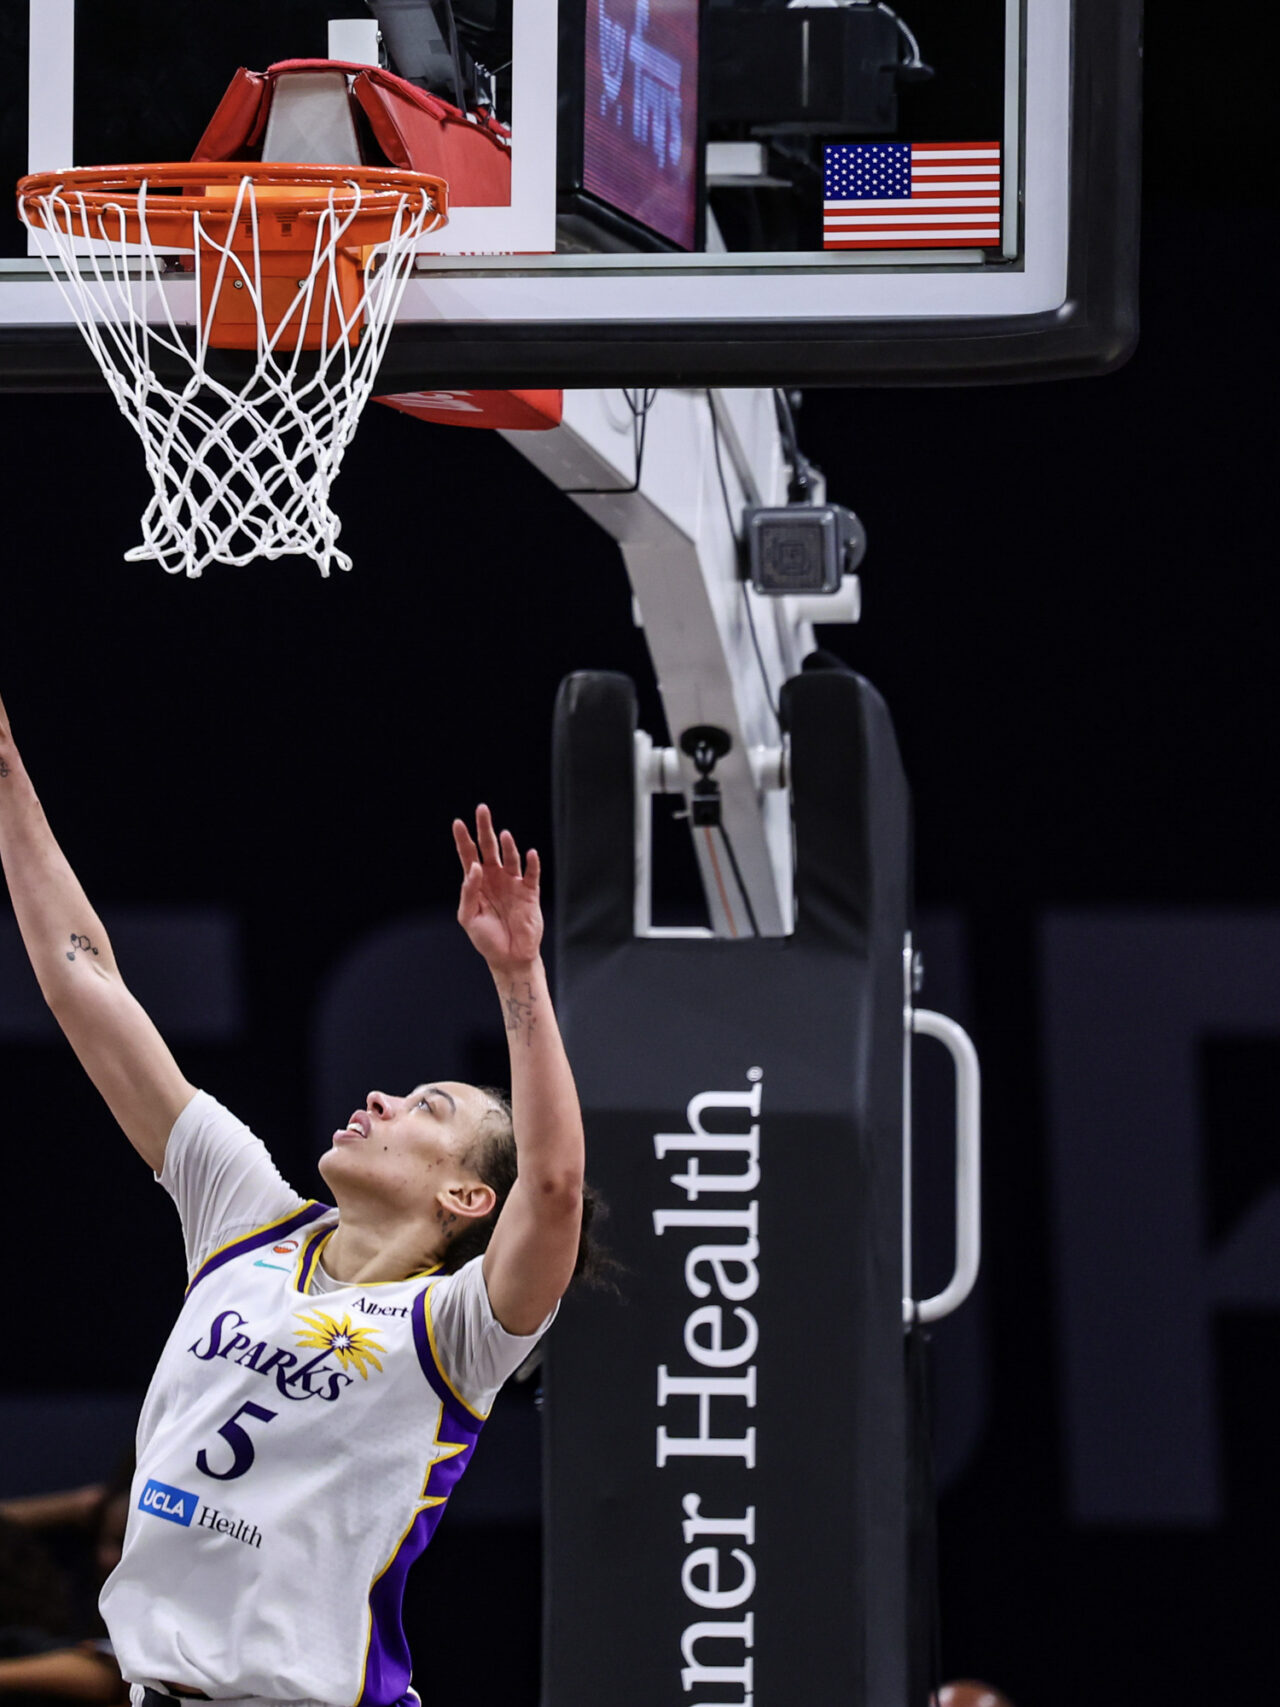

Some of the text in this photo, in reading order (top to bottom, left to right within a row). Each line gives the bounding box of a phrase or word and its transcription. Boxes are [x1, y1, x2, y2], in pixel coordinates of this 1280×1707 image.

[351, 1297, 409, 1318] Albert
[196, 1400, 279, 1481] 5
[143, 1487, 263, 1549] UCLA Health
[680, 1493, 757, 1707] ner
